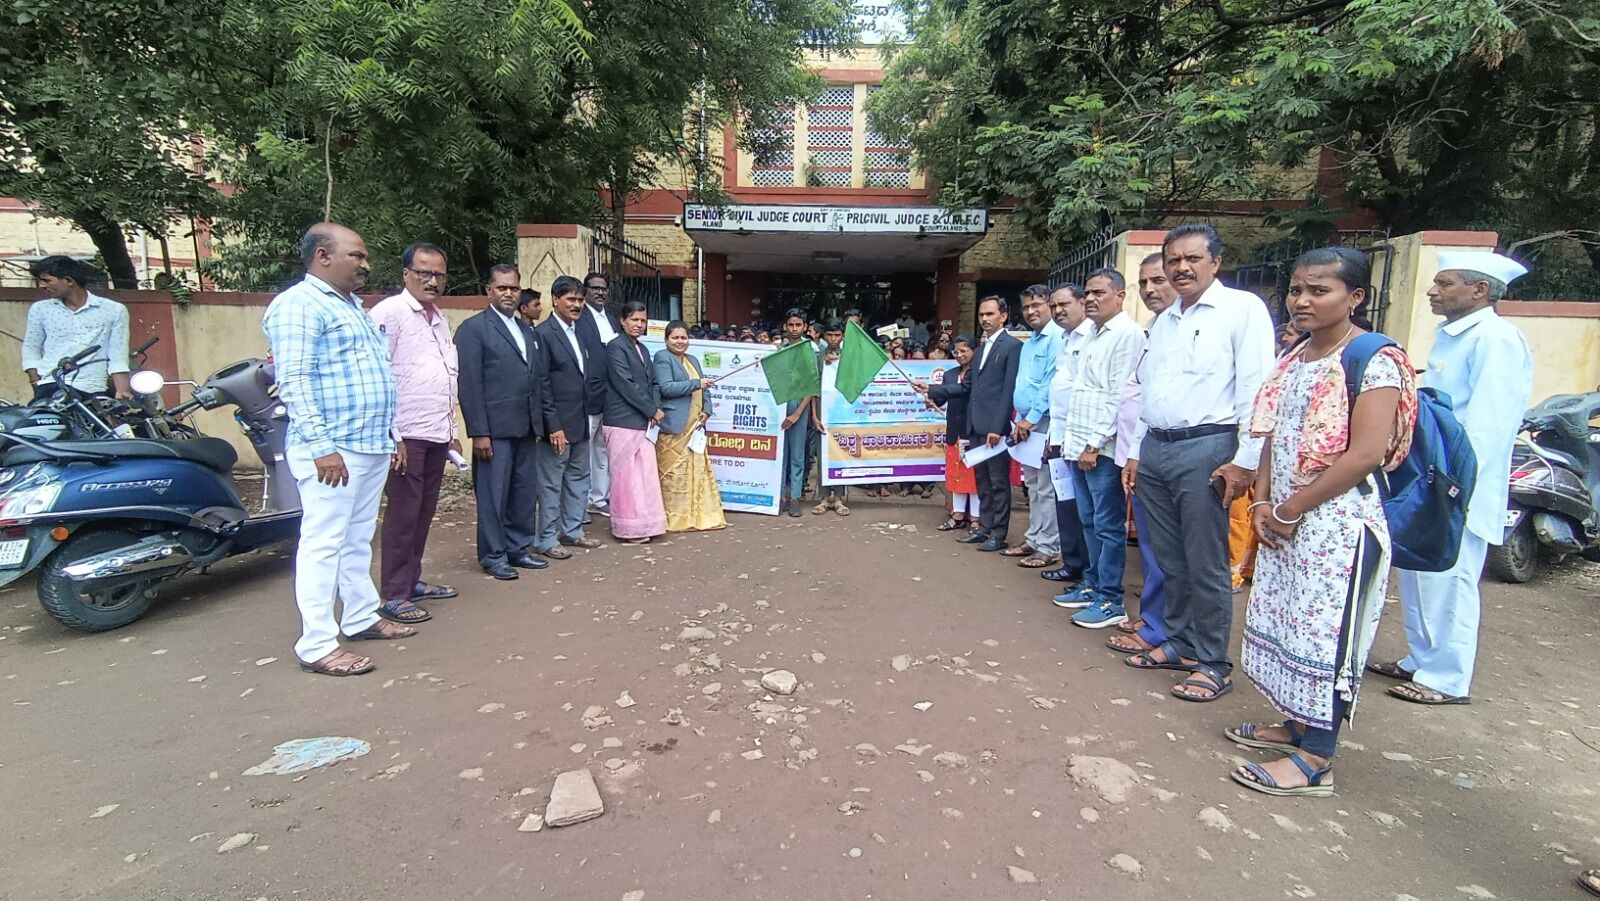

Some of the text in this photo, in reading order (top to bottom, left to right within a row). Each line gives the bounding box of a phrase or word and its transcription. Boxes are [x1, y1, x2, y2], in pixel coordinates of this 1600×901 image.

[687, 209, 828, 223] SENIOR CIVIL JUDGE COURT
[895, 213, 930, 225] JUDGE
[932, 214, 942, 225] &
[702, 220, 723, 228] ALAND
[734, 403, 758, 416] JUST
[733, 415, 767, 428] RIGHTS
[708, 434, 772, 452] ರೋಧಿ ದಿನ
[724, 459, 734, 467] TO
